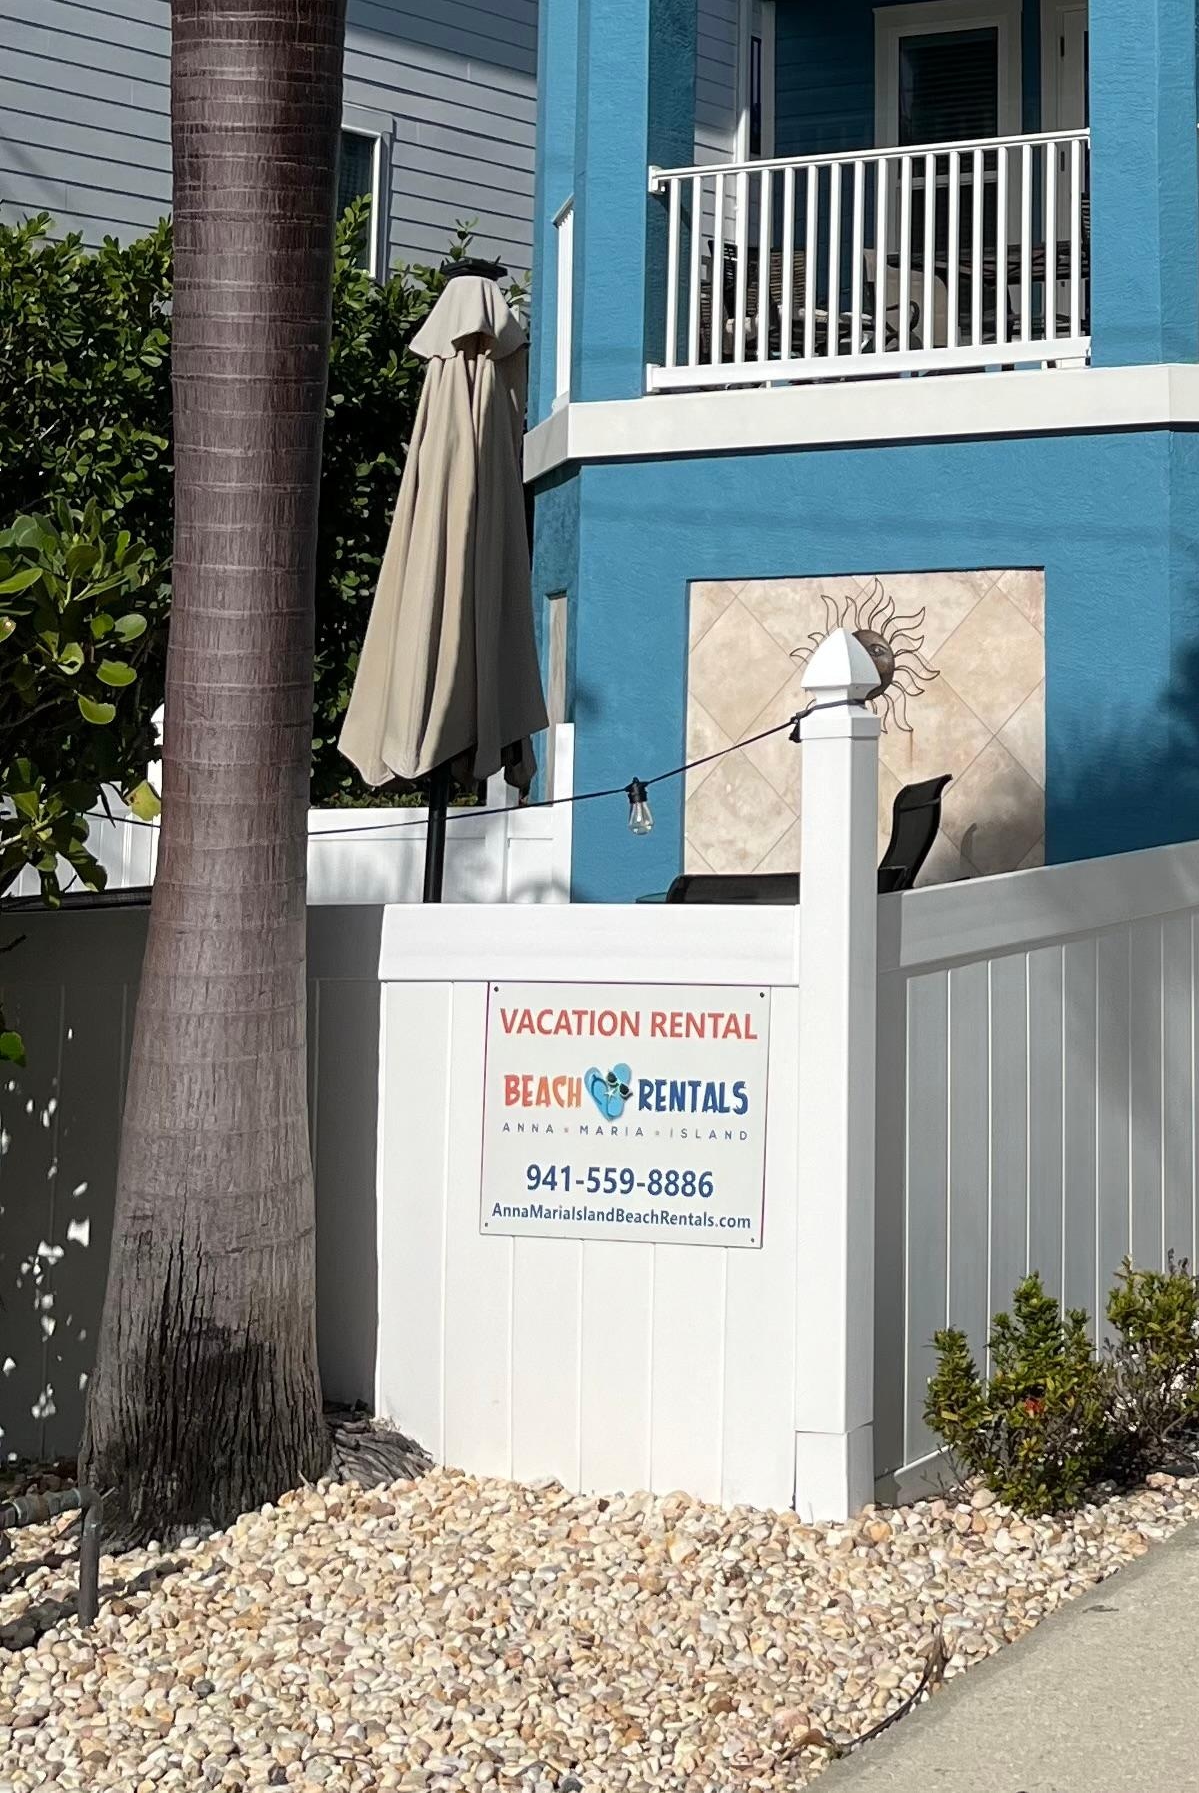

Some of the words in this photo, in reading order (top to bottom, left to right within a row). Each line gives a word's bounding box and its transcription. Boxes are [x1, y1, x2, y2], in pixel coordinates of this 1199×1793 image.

[500, 1008, 640, 1037] VACATION
[650, 1011, 758, 1040] RENTAL
[503, 1074, 583, 1109] BEACH
[638, 1078, 749, 1115] RENTALS
[502, 1122, 554, 1135] ANNA
[579, 1125, 645, 1137] MARIA
[669, 1127, 748, 1141] ISLAND
[526, 1163, 714, 1198] 941-559-8886
[491, 1202, 751, 1229] AnnaMariaIslandBeachRentals.com
